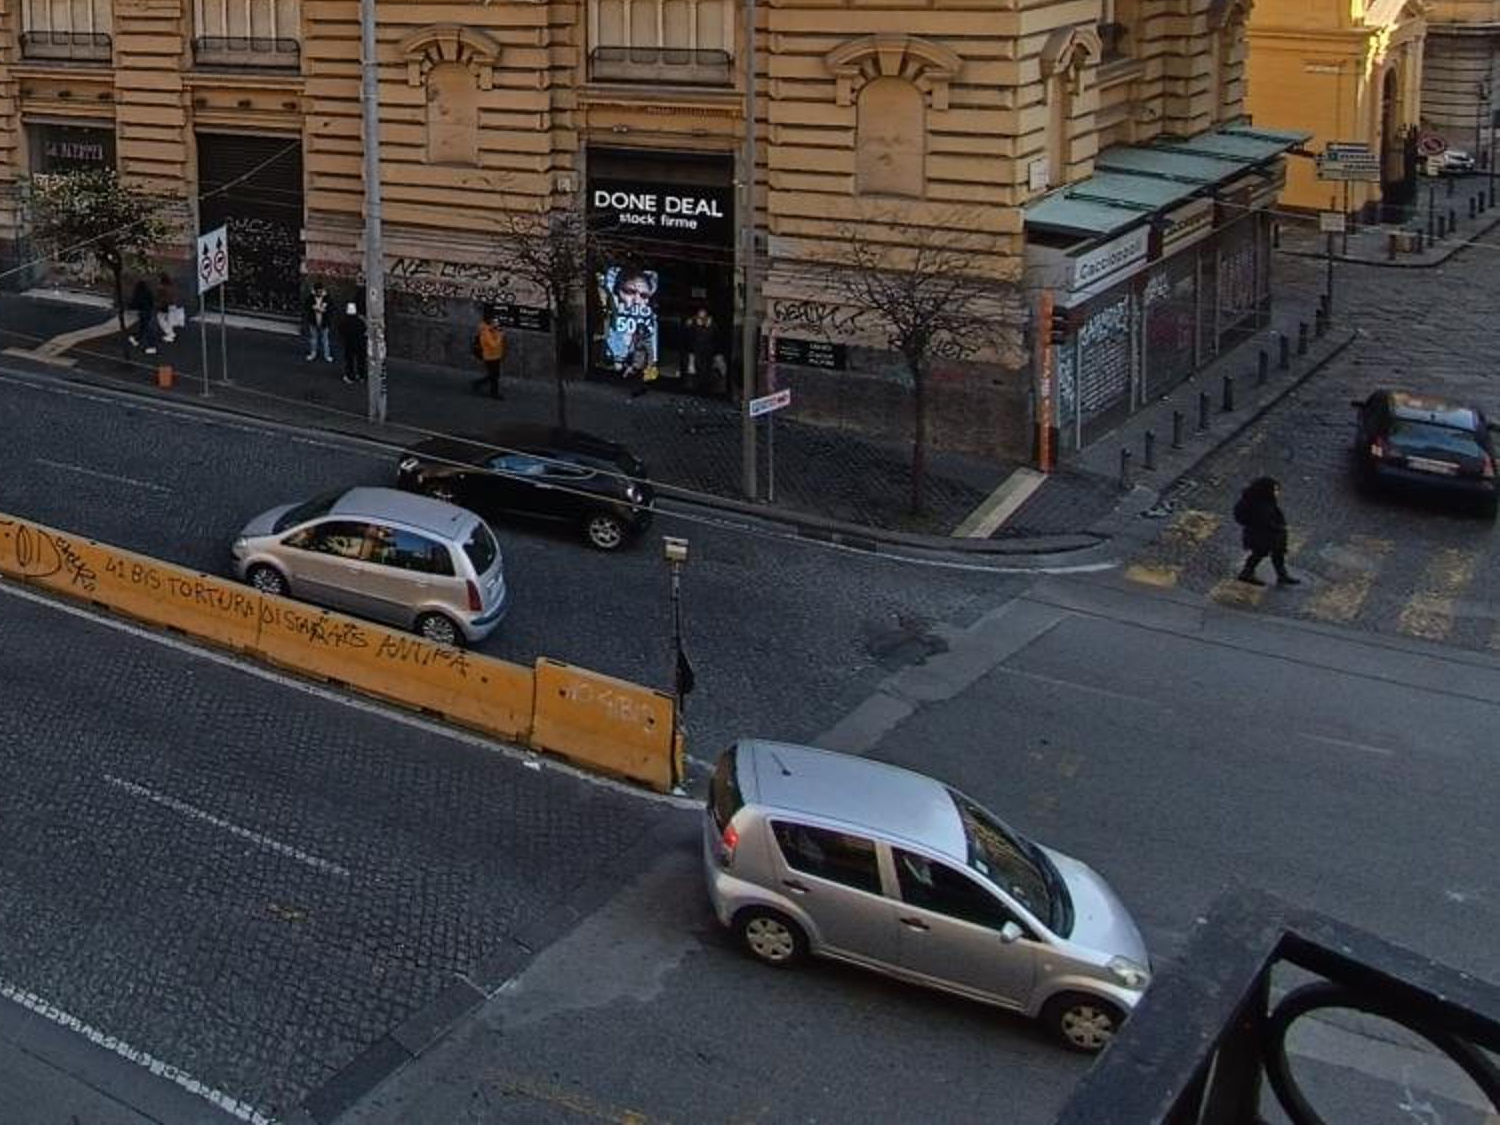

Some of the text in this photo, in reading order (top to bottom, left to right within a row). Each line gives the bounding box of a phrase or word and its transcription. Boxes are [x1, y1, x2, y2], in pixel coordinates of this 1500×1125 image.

[594, 190, 723, 218] DONE DEAL
[619, 213, 698, 230] stock firme
[131, 563, 162, 590] BIS
[166, 577, 256, 619] TORTURA
